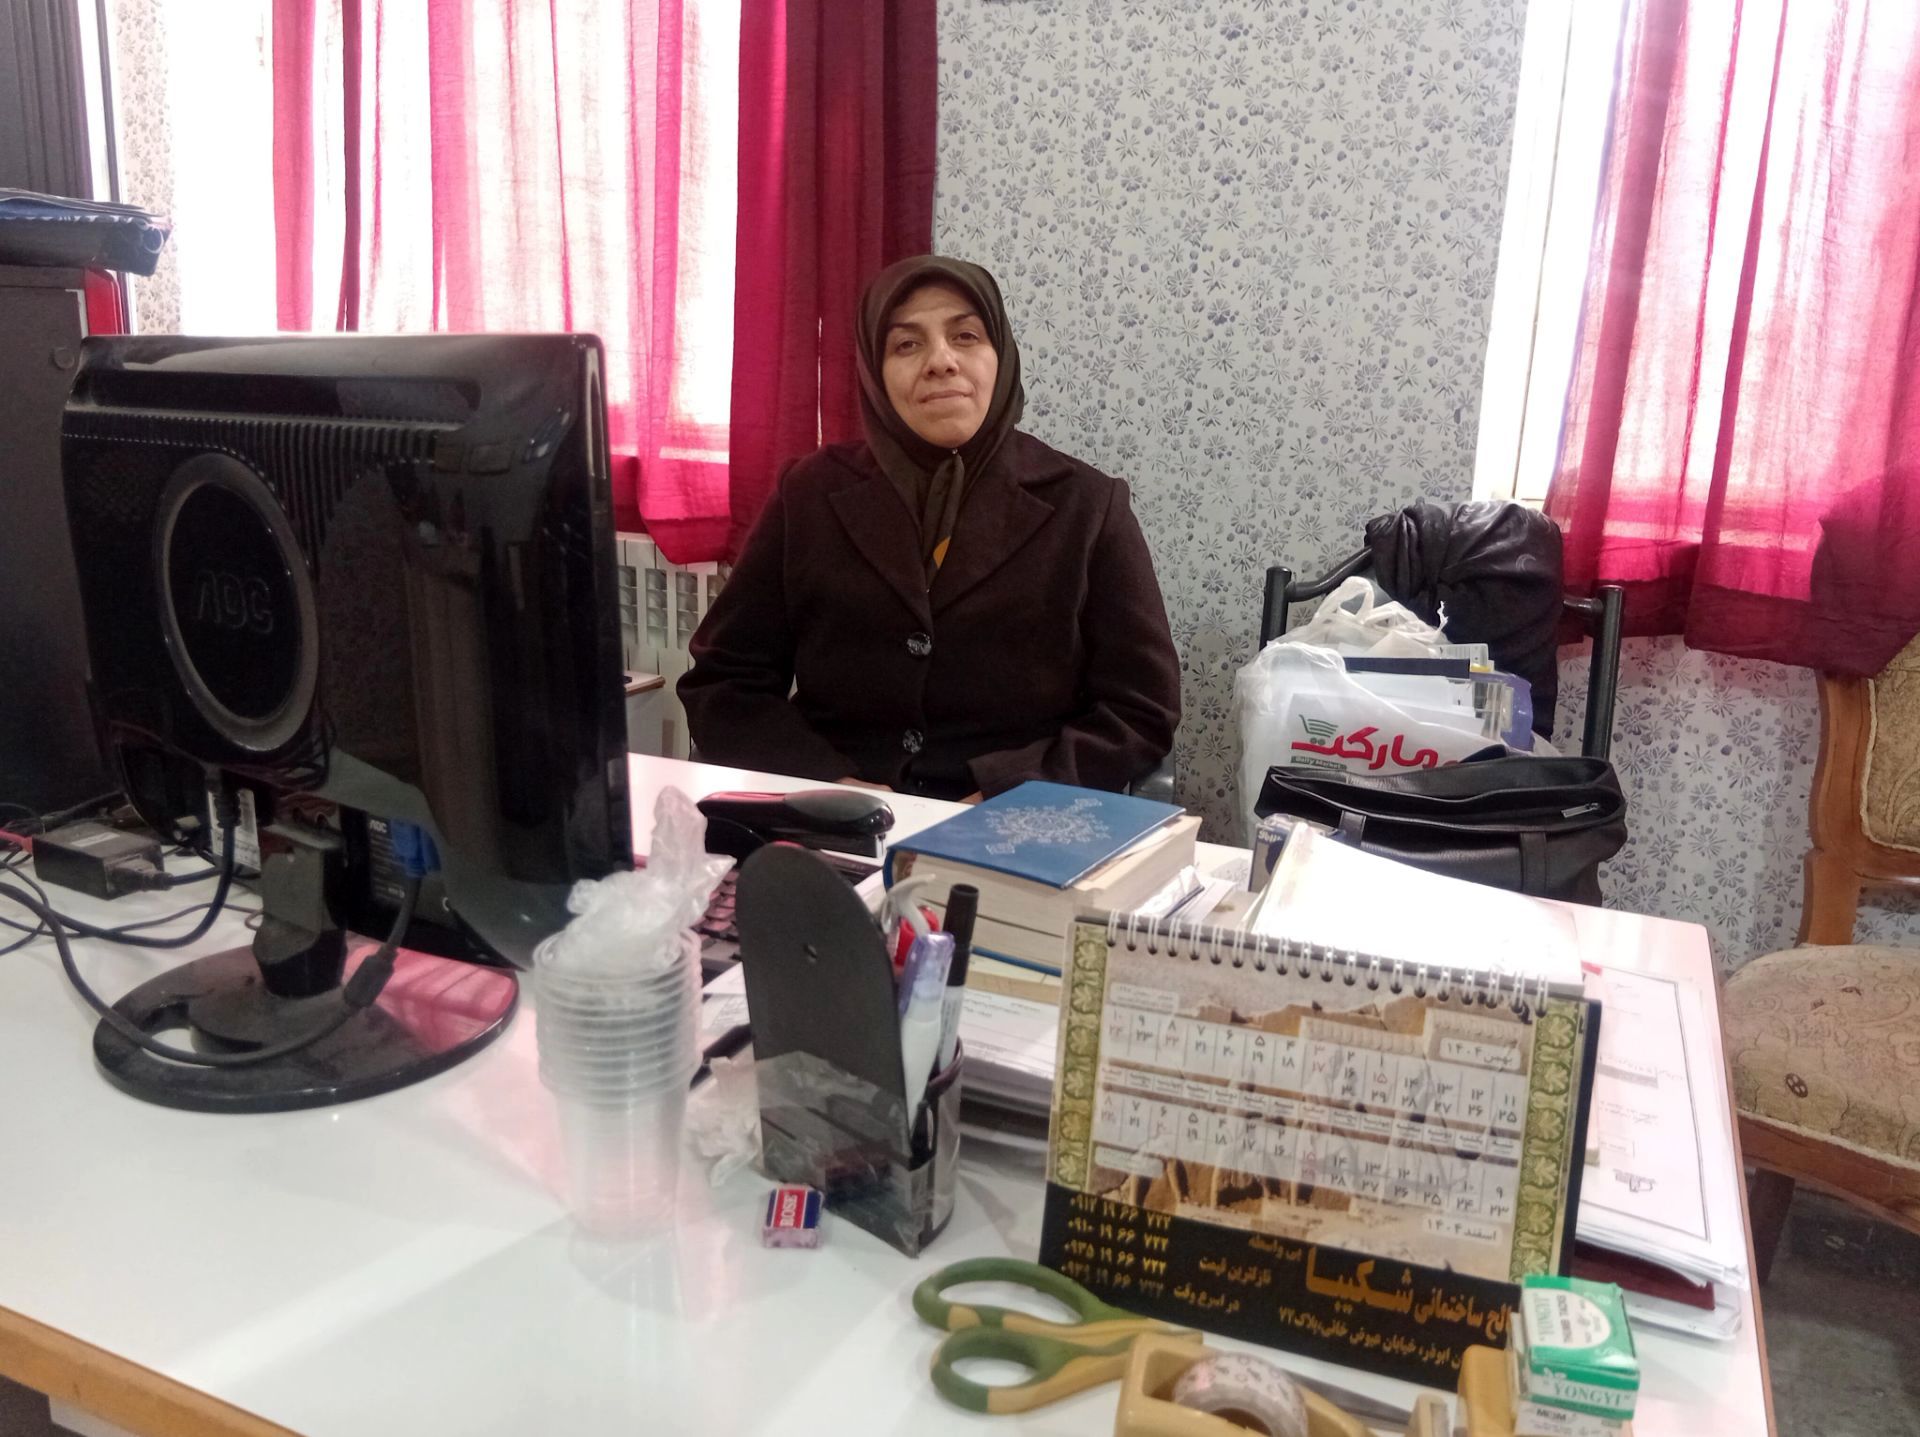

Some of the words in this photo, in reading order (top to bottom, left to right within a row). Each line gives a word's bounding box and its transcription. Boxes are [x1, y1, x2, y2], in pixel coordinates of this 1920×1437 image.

[198, 570, 273, 633] AOC
[1138, 1015, 1145, 1026] ۹
[1168, 1021, 1177, 1031] ۸
[1197, 1026, 1206, 1036] ۷
[1226, 1030, 1234, 1040] ۶
[1255, 1035, 1265, 1046] ۵
[1447, 1043, 1480, 1056] ۱۴۰۴
[1483, 1050, 1513, 1066] بهمن
[1252, 1050, 1264, 1063] ۱۹
[1282, 1056, 1295, 1069] ۱۸
[1311, 1062, 1325, 1074] ۱۷
[1344, 1067, 1357, 1078] ۱۶
[1372, 1072, 1387, 1084] ۱۵
[1404, 1077, 1420, 1088] ۱۴
[1436, 1082, 1453, 1094] ۱۳
[1471, 1088, 1484, 1100] ۱۲
[1504, 1094, 1516, 1106] ۱۱
[1132, 1101, 1141, 1111] ۷
[1160, 1105, 1167, 1117] ۶
[1188, 1112, 1198, 1124] ۵
[1371, 1091, 1387, 1103] ۲۹
[1401, 1097, 1418, 1109] ۲۸
[1434, 1101, 1451, 1114] ۲۷
[1468, 1104, 1484, 1117] ۲۶
[1498, 1110, 1517, 1124] ۲۵
[1187, 1128, 1198, 1139] ۱۹
[1215, 1134, 1227, 1145] ۱۸
[1242, 1138, 1255, 1150] ۱۷
[1274, 1145, 1285, 1156] ۱۶
[1302, 1151, 1317, 1162] ۱۵
[1333, 1157, 1347, 1167] ۱۴
[1365, 1161, 1381, 1173] ۱۳
[1398, 1168, 1410, 1179] ۱۲
[1428, 1174, 1440, 1185] ۱۱
[1464, 1181, 1475, 1192] ۱۰
[1496, 1187, 1504, 1198] ۹
[1330, 1174, 1347, 1187] ۲۸
[1362, 1180, 1379, 1192] ۲۷
[1394, 1185, 1409, 1198] ۲۶
[1423, 1192, 1442, 1206] ۲۵
[1456, 1198, 1474, 1209] ۲۴
[1489, 1204, 1509, 1216] ۲۳
[1427, 1219, 1462, 1234] ۱۴۰۴
[1464, 1225, 1497, 1241] اسفند
[1414, 1287, 1484, 1327] ساختمانی
